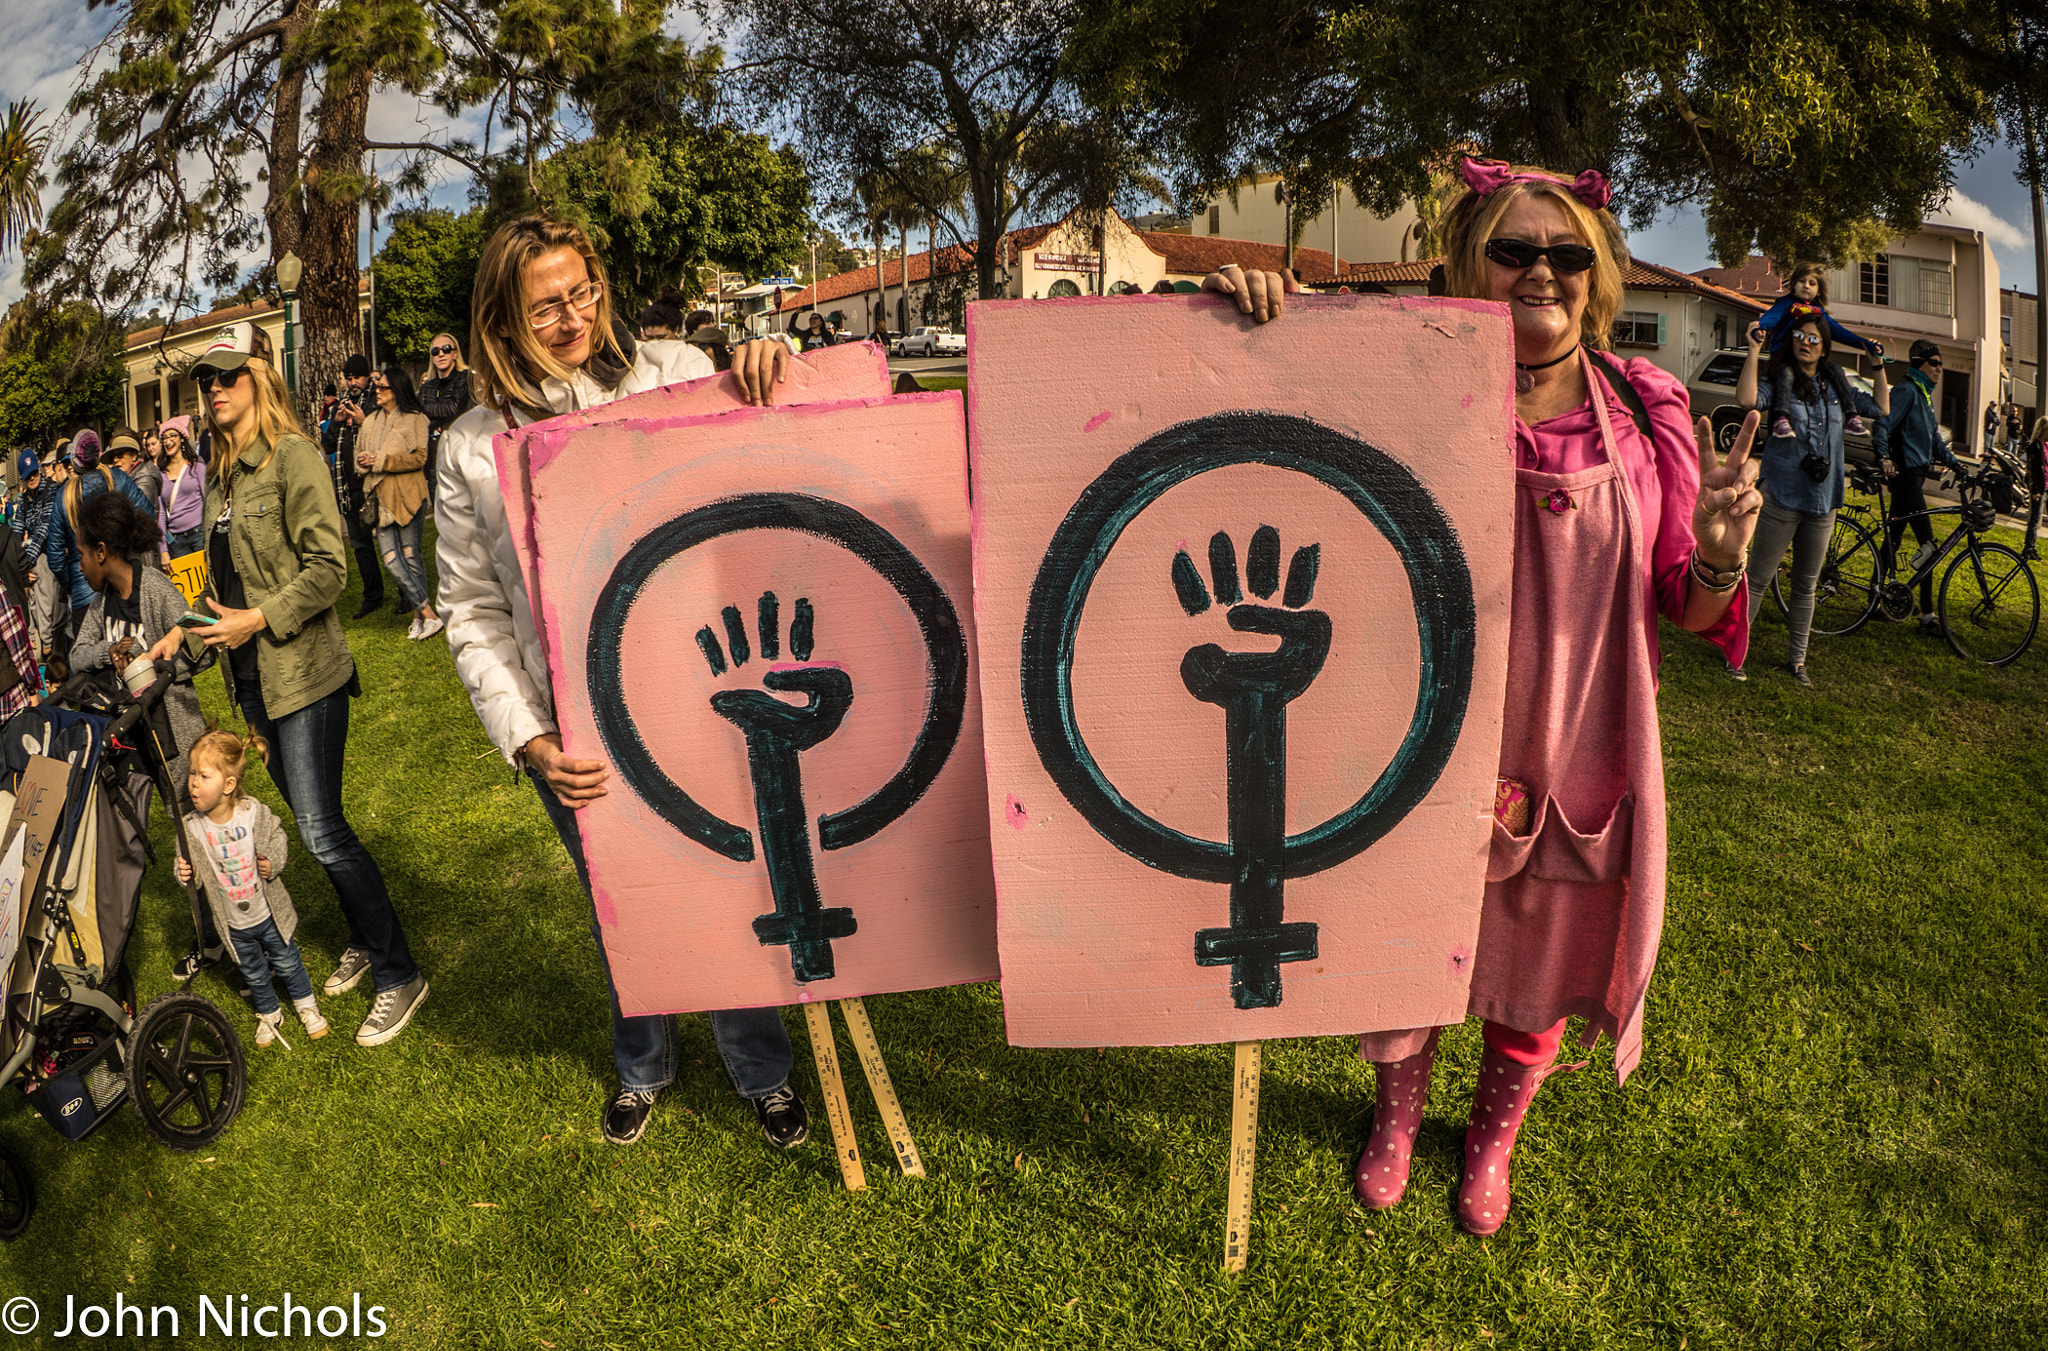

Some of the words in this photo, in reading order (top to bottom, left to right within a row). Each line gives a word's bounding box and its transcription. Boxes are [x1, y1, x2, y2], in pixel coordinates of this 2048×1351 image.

[14, 775, 48, 816] LOVE
[206, 826, 247, 846] KIND
[222, 843, 239, 858] IS
[216, 855, 252, 873] THE
[218, 866, 254, 887] NEW
[220, 883, 259, 900] OOL
